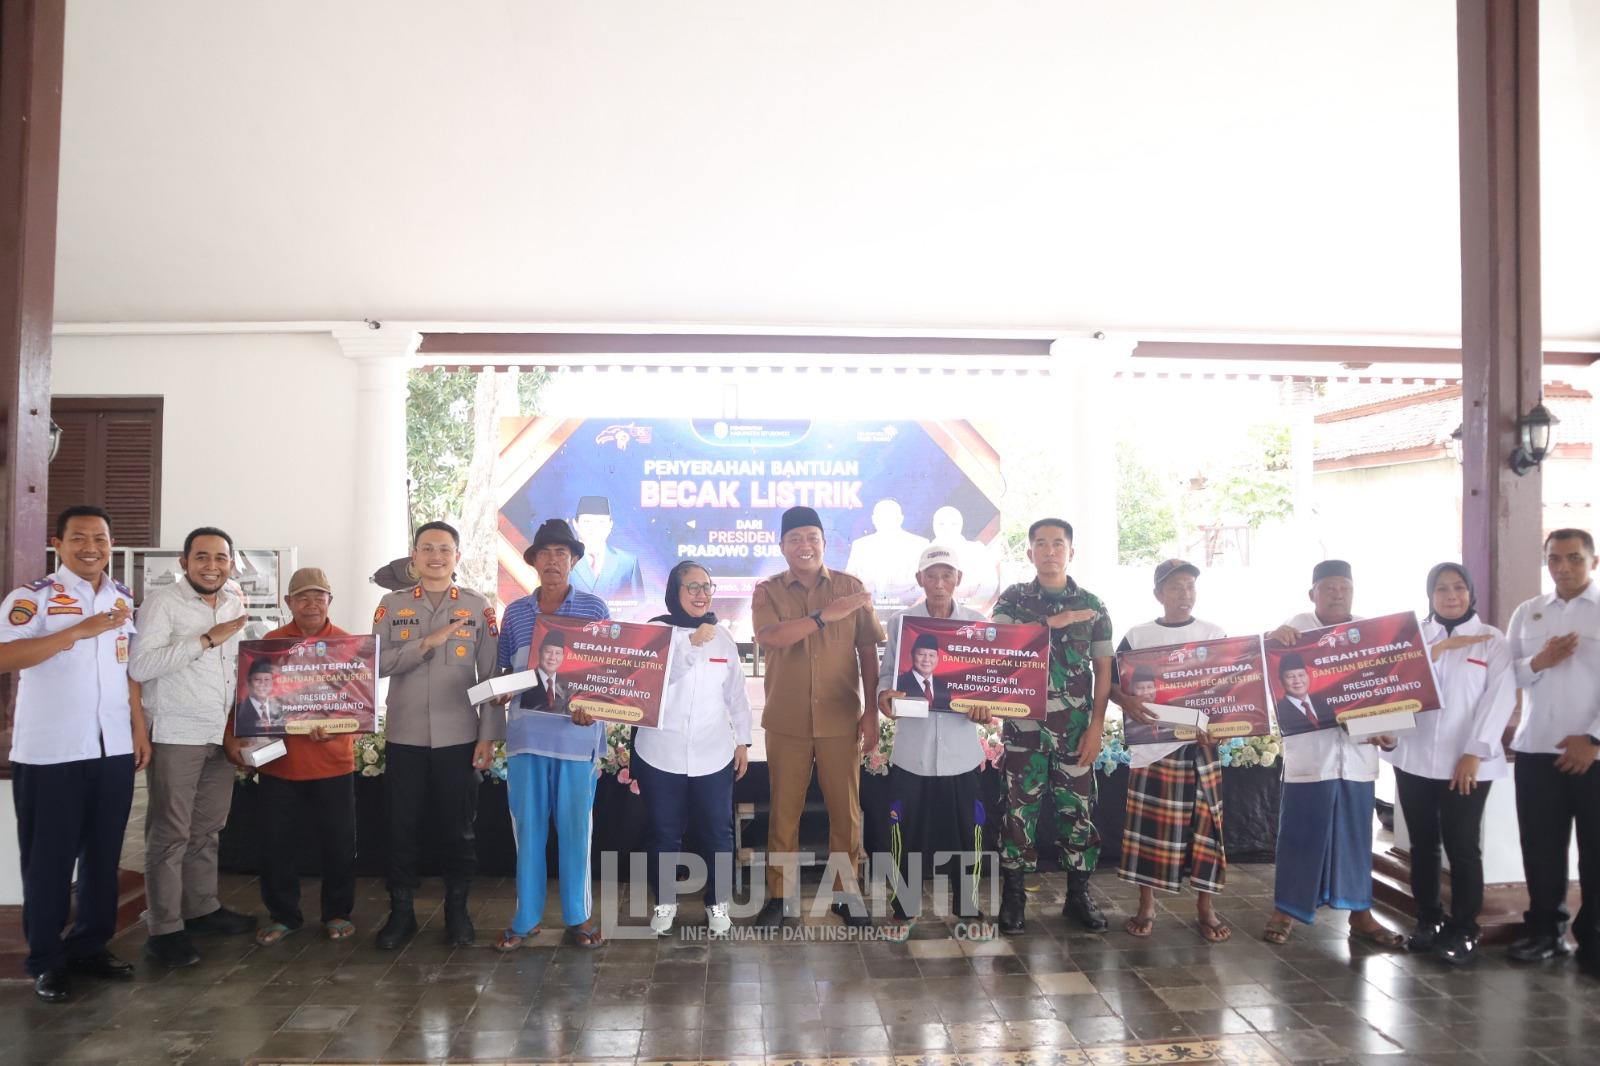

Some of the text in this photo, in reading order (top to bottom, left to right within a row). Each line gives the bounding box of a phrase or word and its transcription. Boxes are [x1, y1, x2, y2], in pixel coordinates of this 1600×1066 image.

[643, 460, 859, 476] PENYERAHAN BANTUAN
[640, 480, 863, 509] BECAK LISTRIK
[736, 519, 763, 530] DARI
[708, 530, 776, 543] PRESIDEN
[678, 545, 749, 557] PRABOWO
[573, 642, 659, 658] SERAH TERIMA
[947, 644, 1040, 658] SERAH TERIMA
[1313, 640, 1413, 666] SERAH TERIMA
[281, 661, 367, 673] SERAH TERIMA
[567, 654, 663, 671] BANTUAN BECAK LISTRIK
[942, 655, 1046, 670] BANTUAN BECAK LISTRIK
[1312, 650, 1424, 678] BANTUAN BECAK LISTRIK
[316, 674, 342, 683] BECAK
[344, 672, 373, 681] LISTRIK
[1162, 663, 1254, 679] SERAH TERIMA
[586, 674, 635, 687] PRESIDEN RI
[965, 674, 1018, 685] PRESIDEN RI
[1159, 673, 1262, 691] BANTUAN BECAK LISTRIK
[1343, 674, 1399, 691] PRESIDEN RI
[567, 681, 651, 700] PRABOWO SUBIANTO
[947, 682, 1036, 696] PRABOWO SUBIANTO
[1326, 681, 1422, 705] PRABOWO SUBIANTO
[299, 692, 347, 701] PRESIDEN RI
[1185, 696, 1236, 707] PRESIDEN RI
[282, 702, 364, 712] PRABOWO SUBIANTO
[1211, 704, 1255, 715] SUBIANTO
